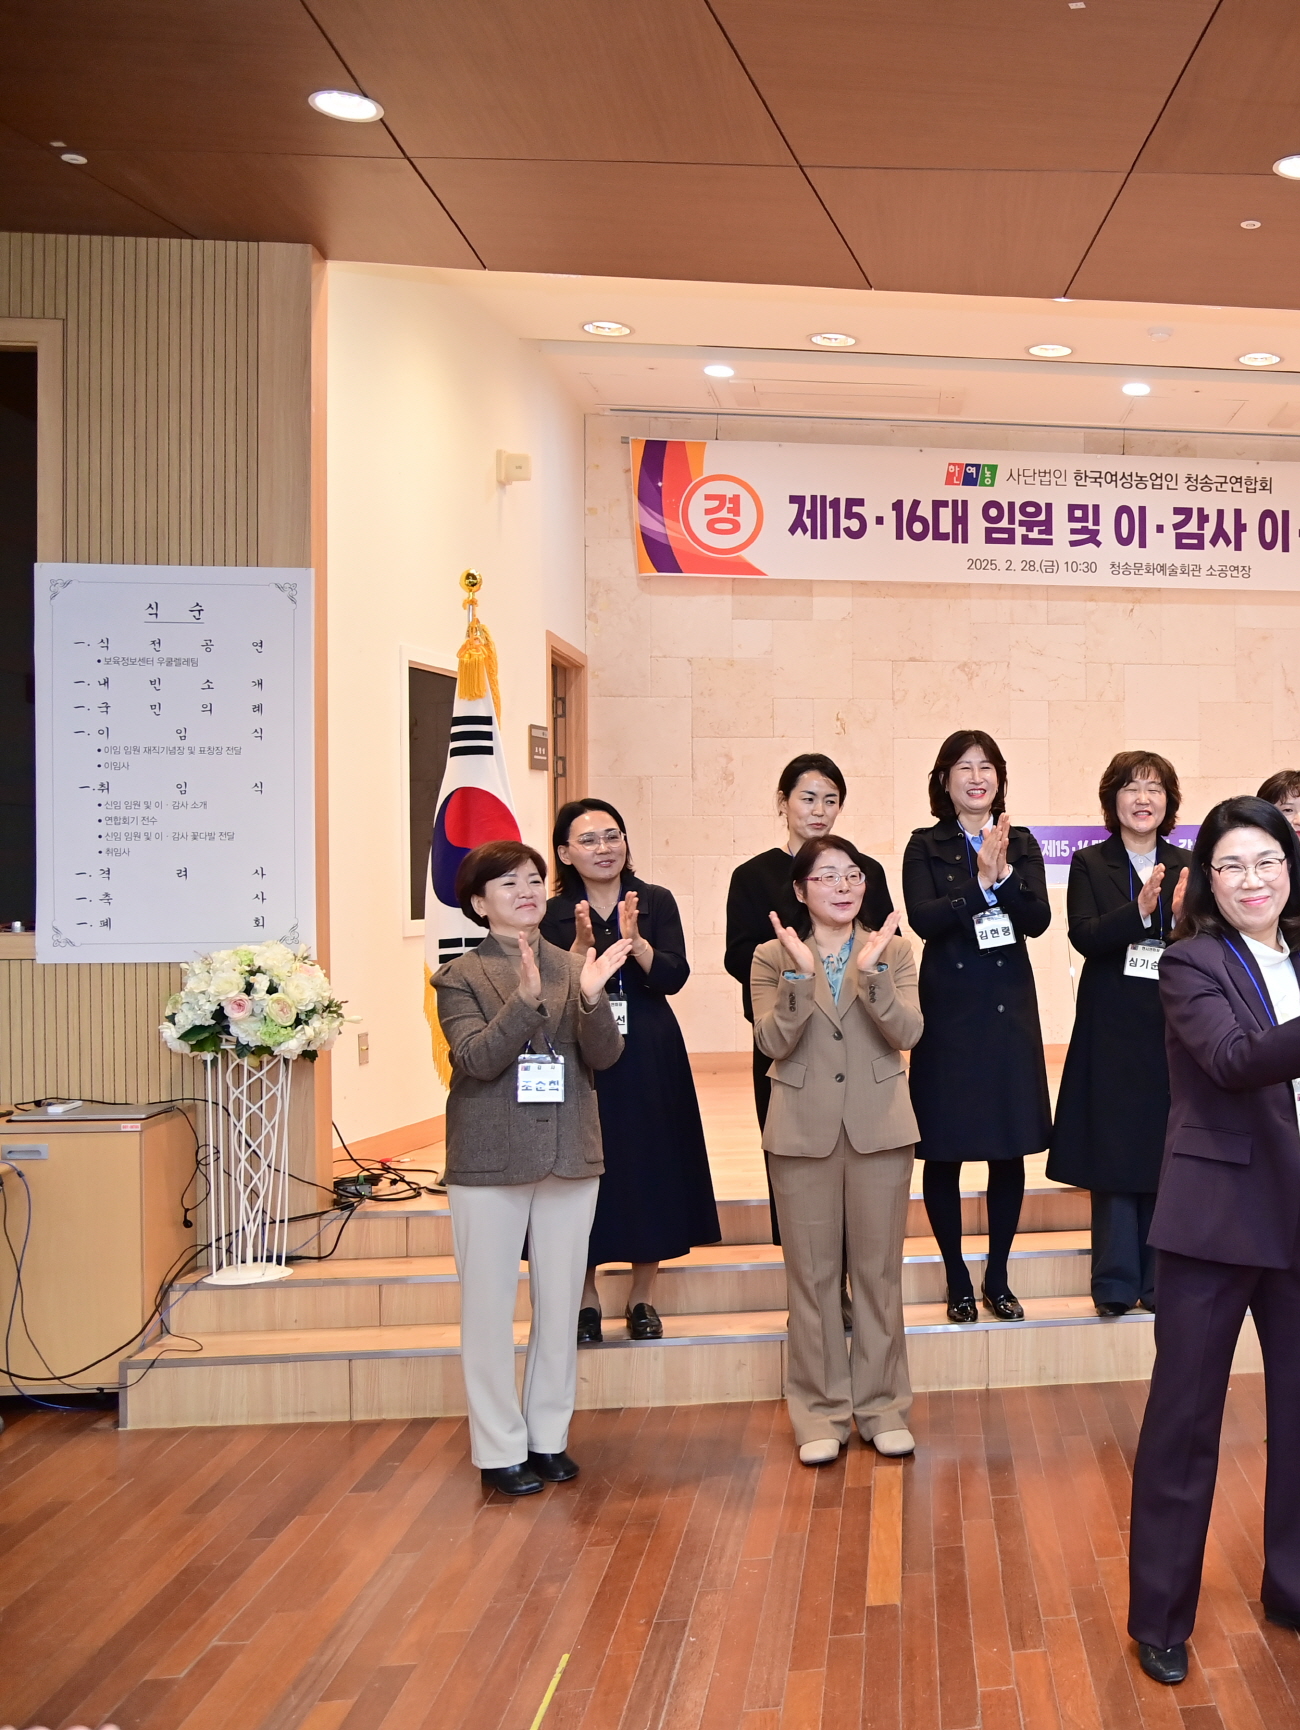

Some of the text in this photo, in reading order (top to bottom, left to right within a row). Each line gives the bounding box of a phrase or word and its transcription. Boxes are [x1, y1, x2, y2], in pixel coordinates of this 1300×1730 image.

[948, 464, 992, 486] 한여농
[1006, 467, 1273, 495] 사단법인 한국여성농업인 청송군연합회
[703, 493, 742, 536] 경
[981, 499, 1054, 546] 임원
[1067, 503, 1103, 549] 및
[966, 558, 1001, 572] 2025.
[1064, 560, 1098, 574] 10:30
[1109, 561, 1203, 578] 청송문화예술회관
[1205, 564, 1252, 579] 소공연장
[103, 656, 154, 667] 보육정보센터
[104, 745, 242, 755] 이임 임원 재직기념장 및 표창장 전달
[104, 761, 130, 771] 이임사
[104, 800, 121, 810] 신임
[124, 800, 141, 810] 임원
[143, 800, 152, 810] 및
[190, 800, 208, 810] 소개
[104, 815, 158, 826] 연합회기 전수
[105, 831, 122, 841] 신임
[124, 831, 141, 841] 임원
[143, 831, 152, 841] 및
[190, 831, 216, 841] 꽃다발
[218, 831, 235, 841] 전달
[105, 847, 130, 857] 취임사
